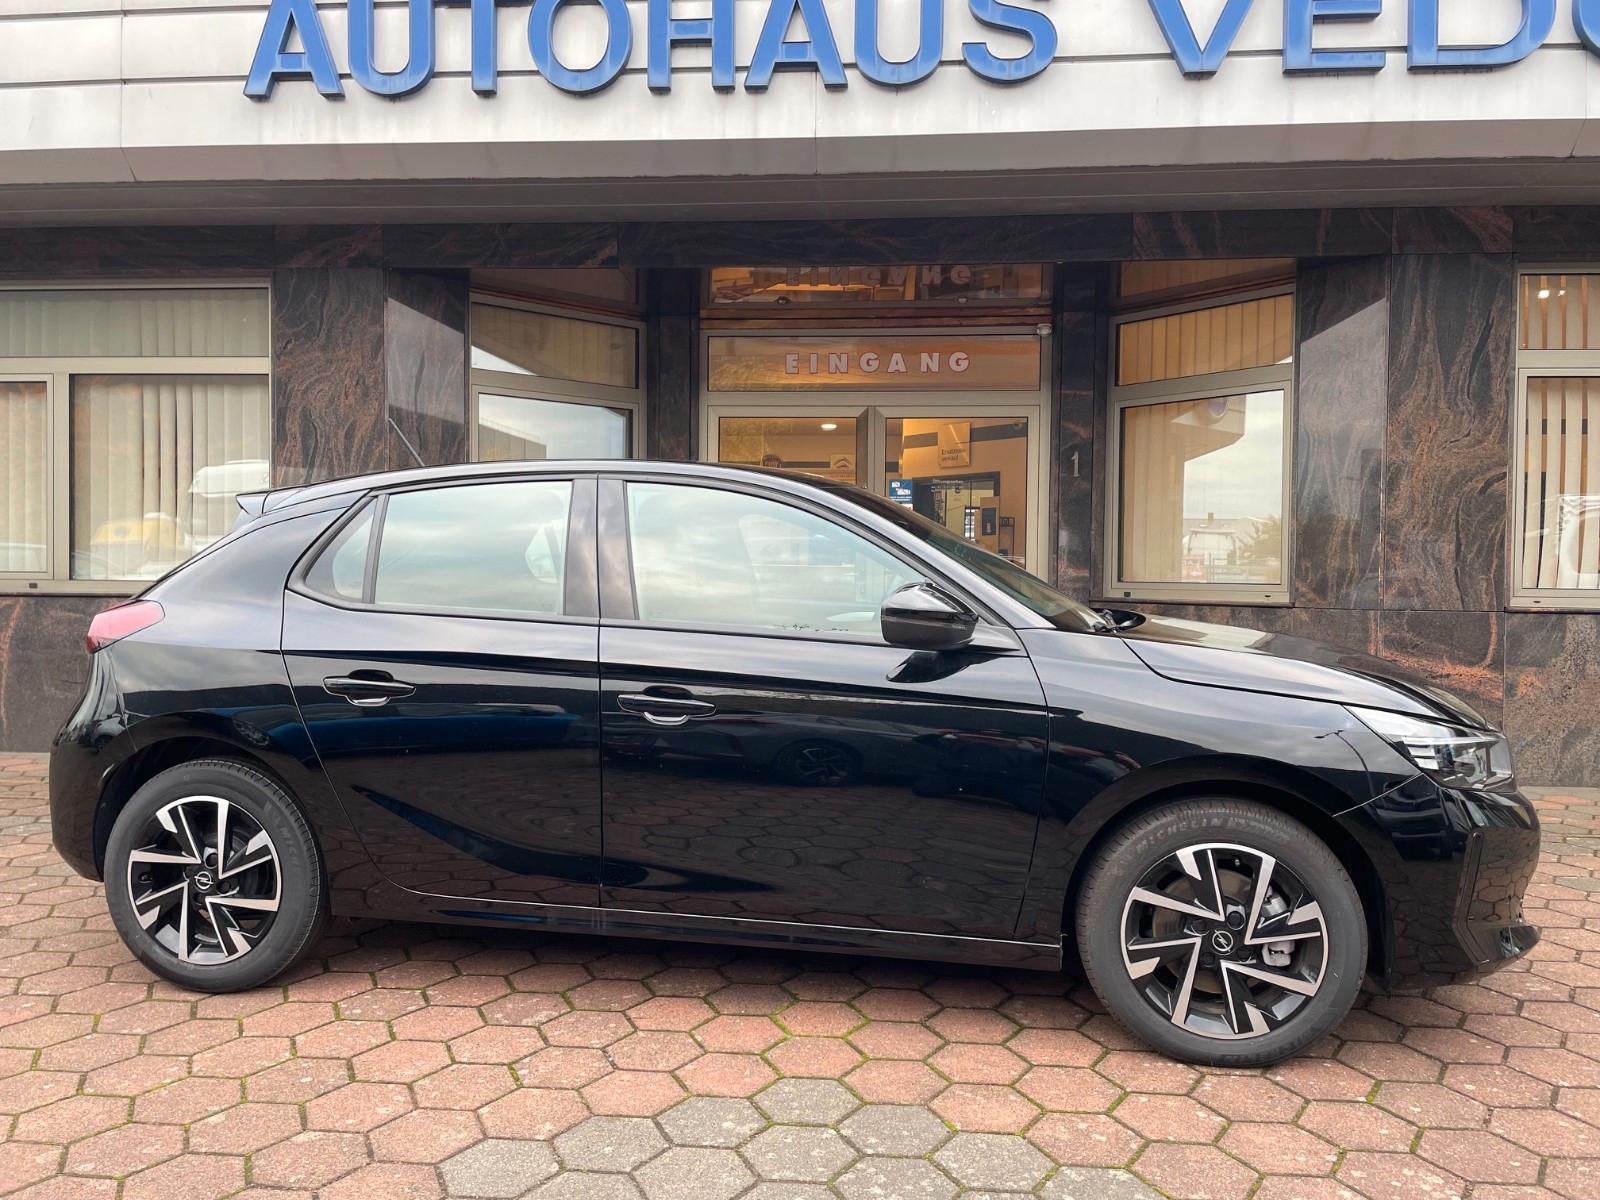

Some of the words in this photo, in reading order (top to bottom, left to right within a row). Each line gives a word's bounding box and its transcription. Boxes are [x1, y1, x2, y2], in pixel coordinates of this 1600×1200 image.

[244, 0, 1058, 99] AUTOHAUS
[785, 351, 971, 375] EINGANG
[1071, 450, 1080, 478] 1
[1136, 818, 1224, 850] MICHELIN
